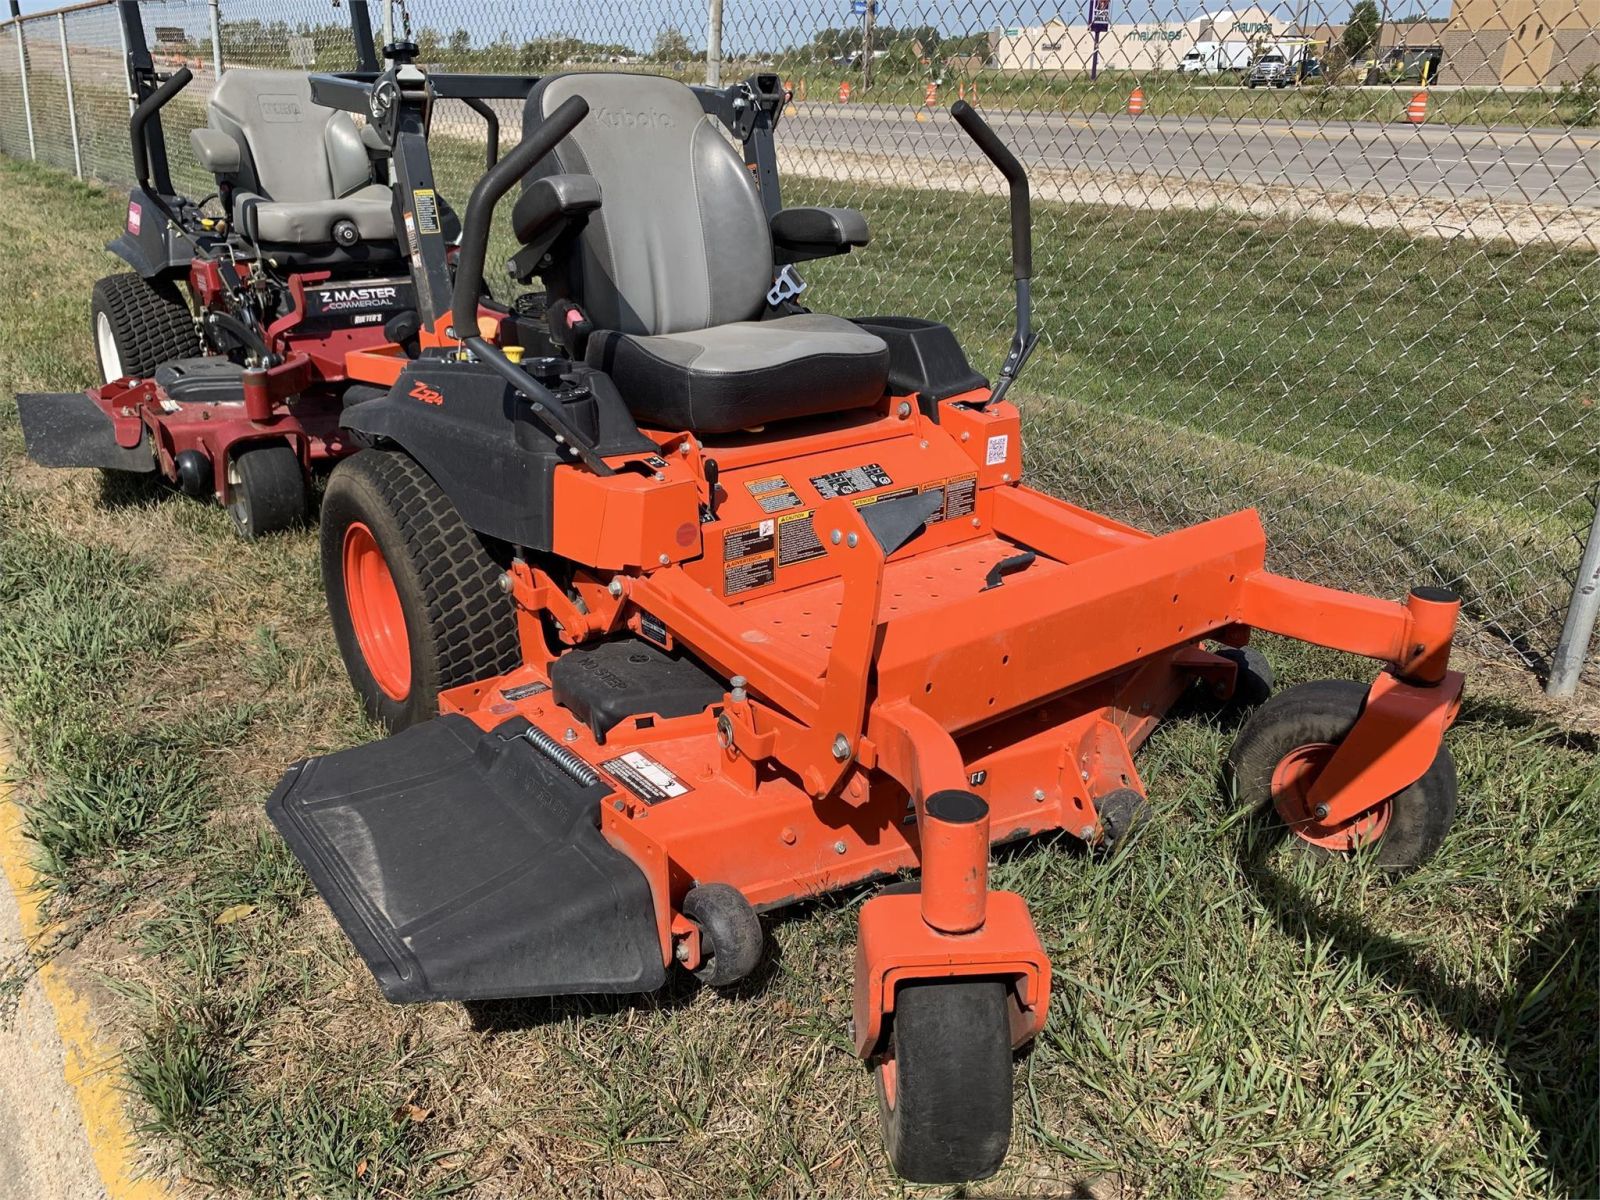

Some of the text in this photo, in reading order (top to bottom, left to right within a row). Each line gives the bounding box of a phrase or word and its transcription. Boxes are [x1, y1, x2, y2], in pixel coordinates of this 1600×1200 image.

[591, 106, 675, 128] Kubota
[320, 287, 397, 303] Z MASTER
[329, 298, 393, 310] COMMERCIAL
[785, 513, 805, 521] CAUTION
[594, 669, 627, 689] STEP
